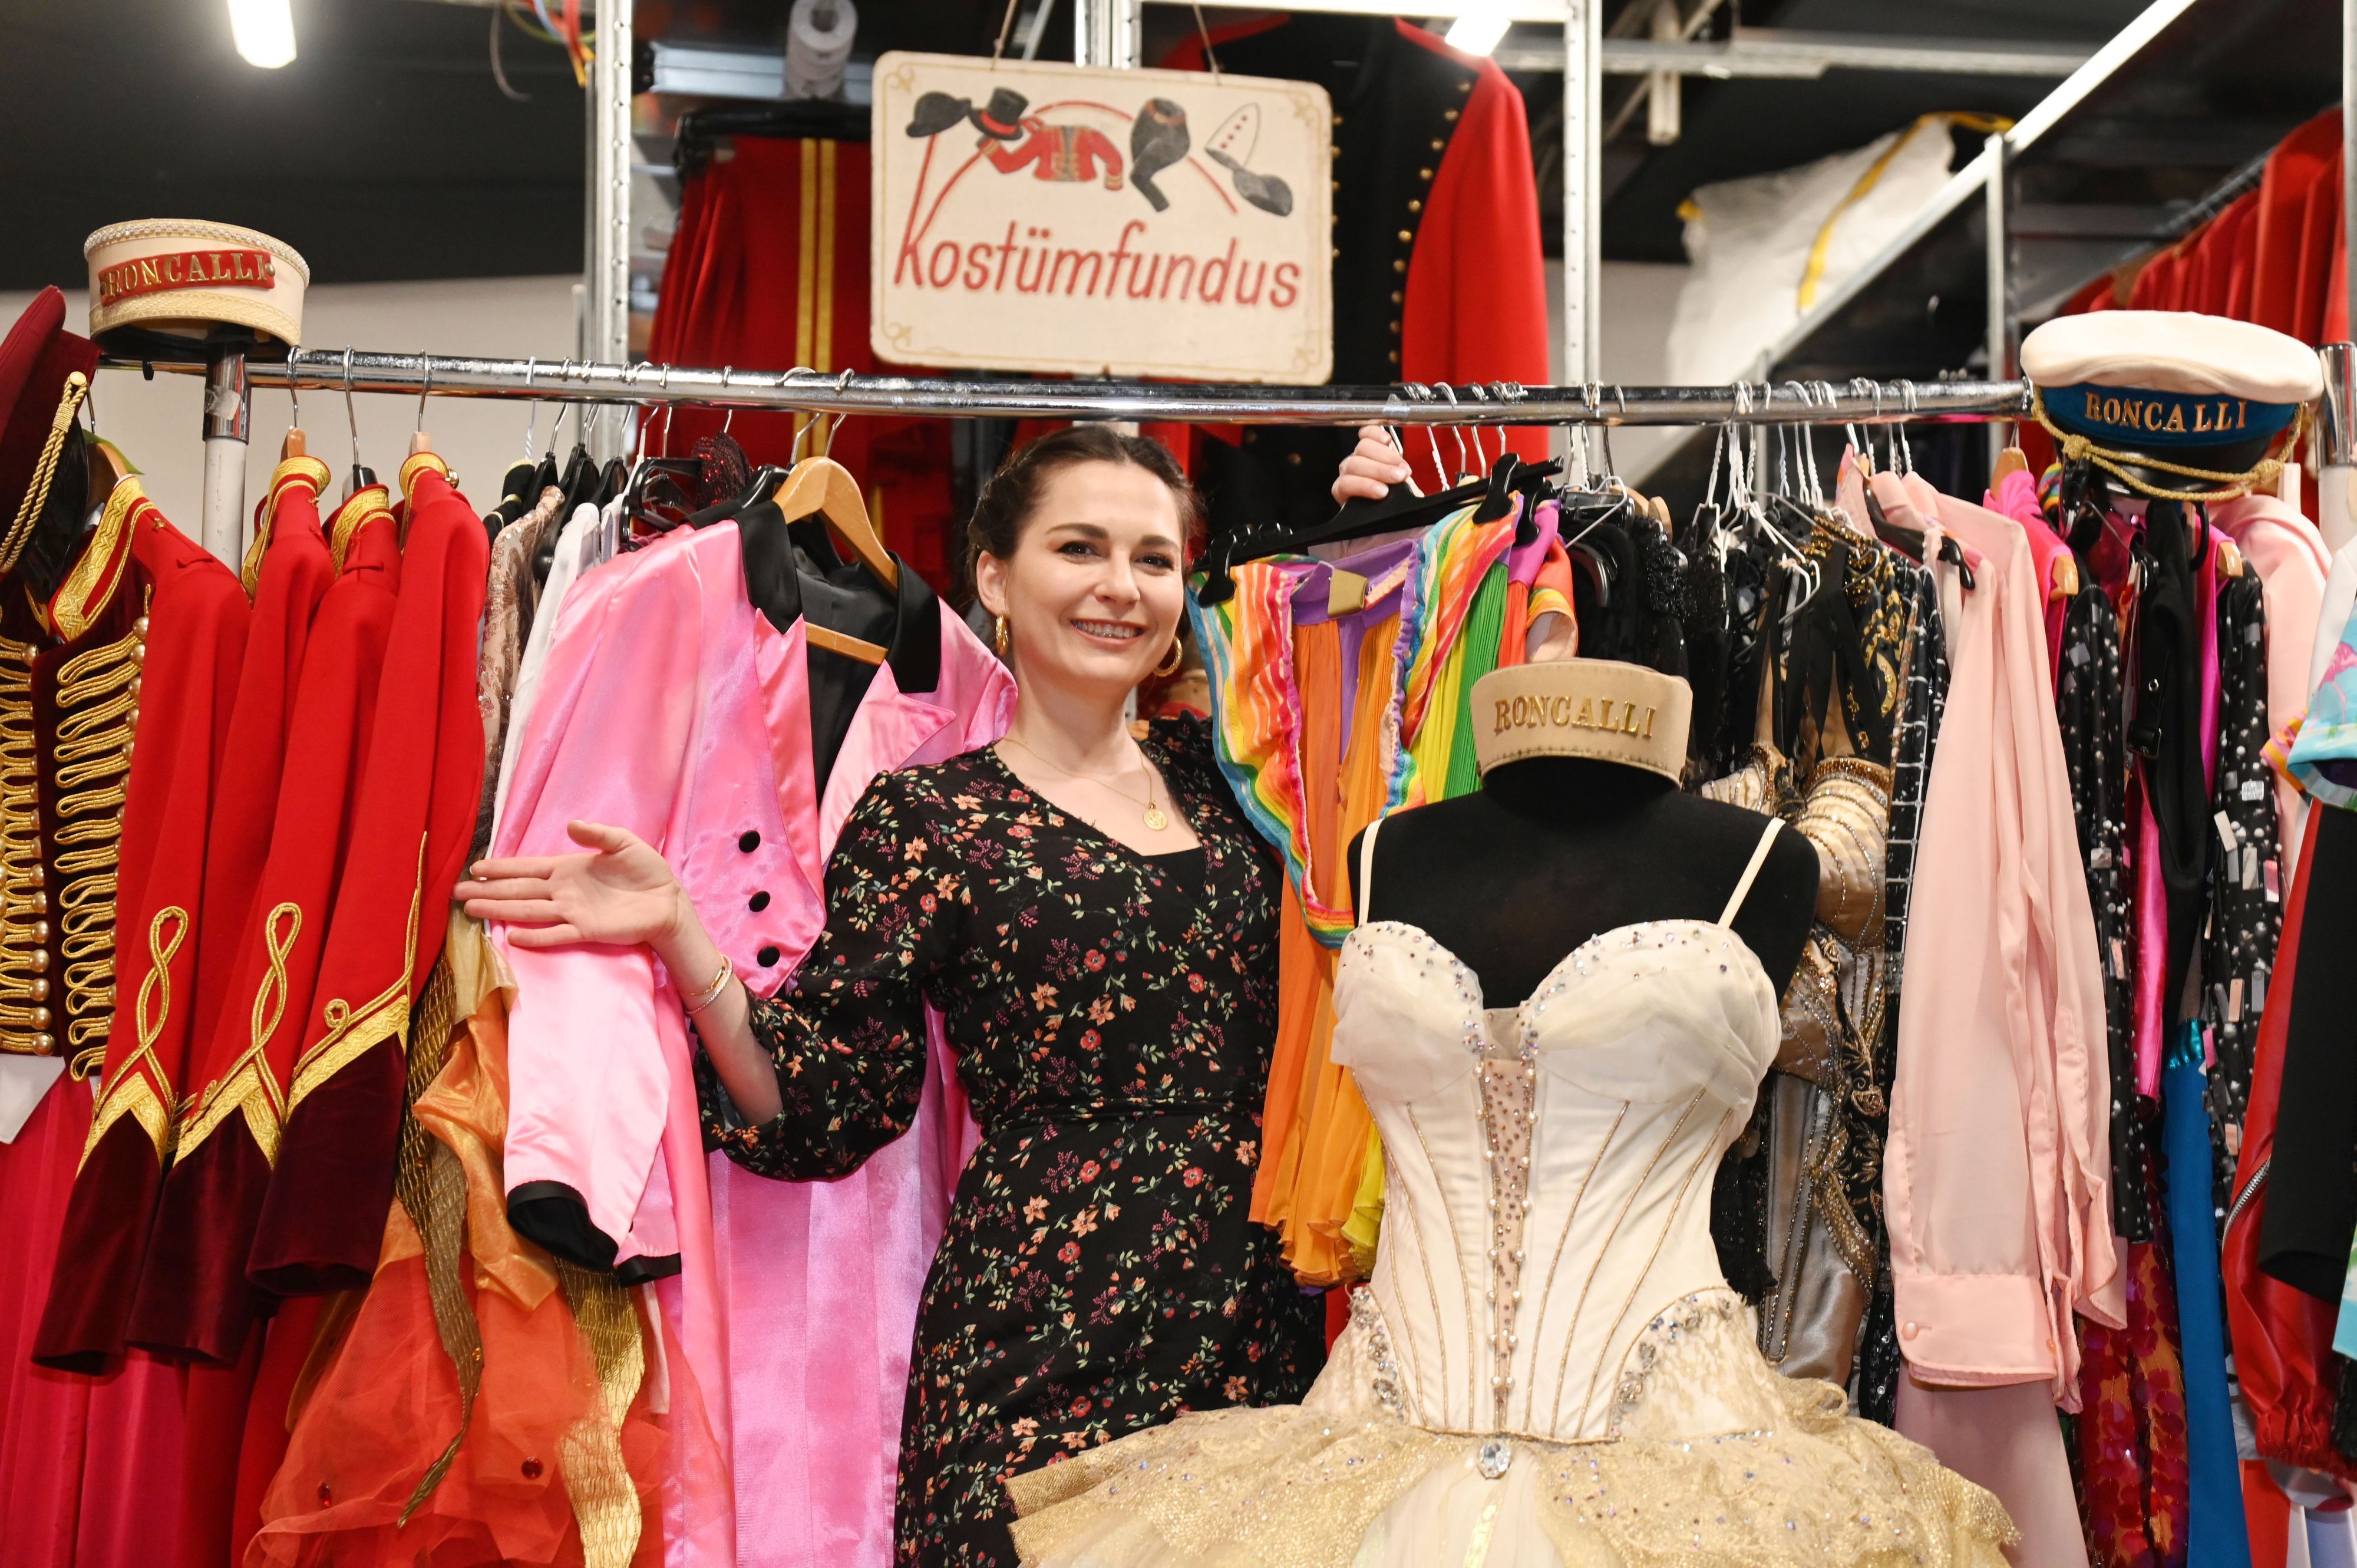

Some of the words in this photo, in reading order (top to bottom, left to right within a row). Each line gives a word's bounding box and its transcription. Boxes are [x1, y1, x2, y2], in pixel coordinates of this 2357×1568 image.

[106, 252, 268, 298] RONCALLI
[893, 218, 1302, 309] Kostümfundus
[2084, 391, 2247, 433] RONCALLI
[1494, 694, 1657, 738] RONCALLI
